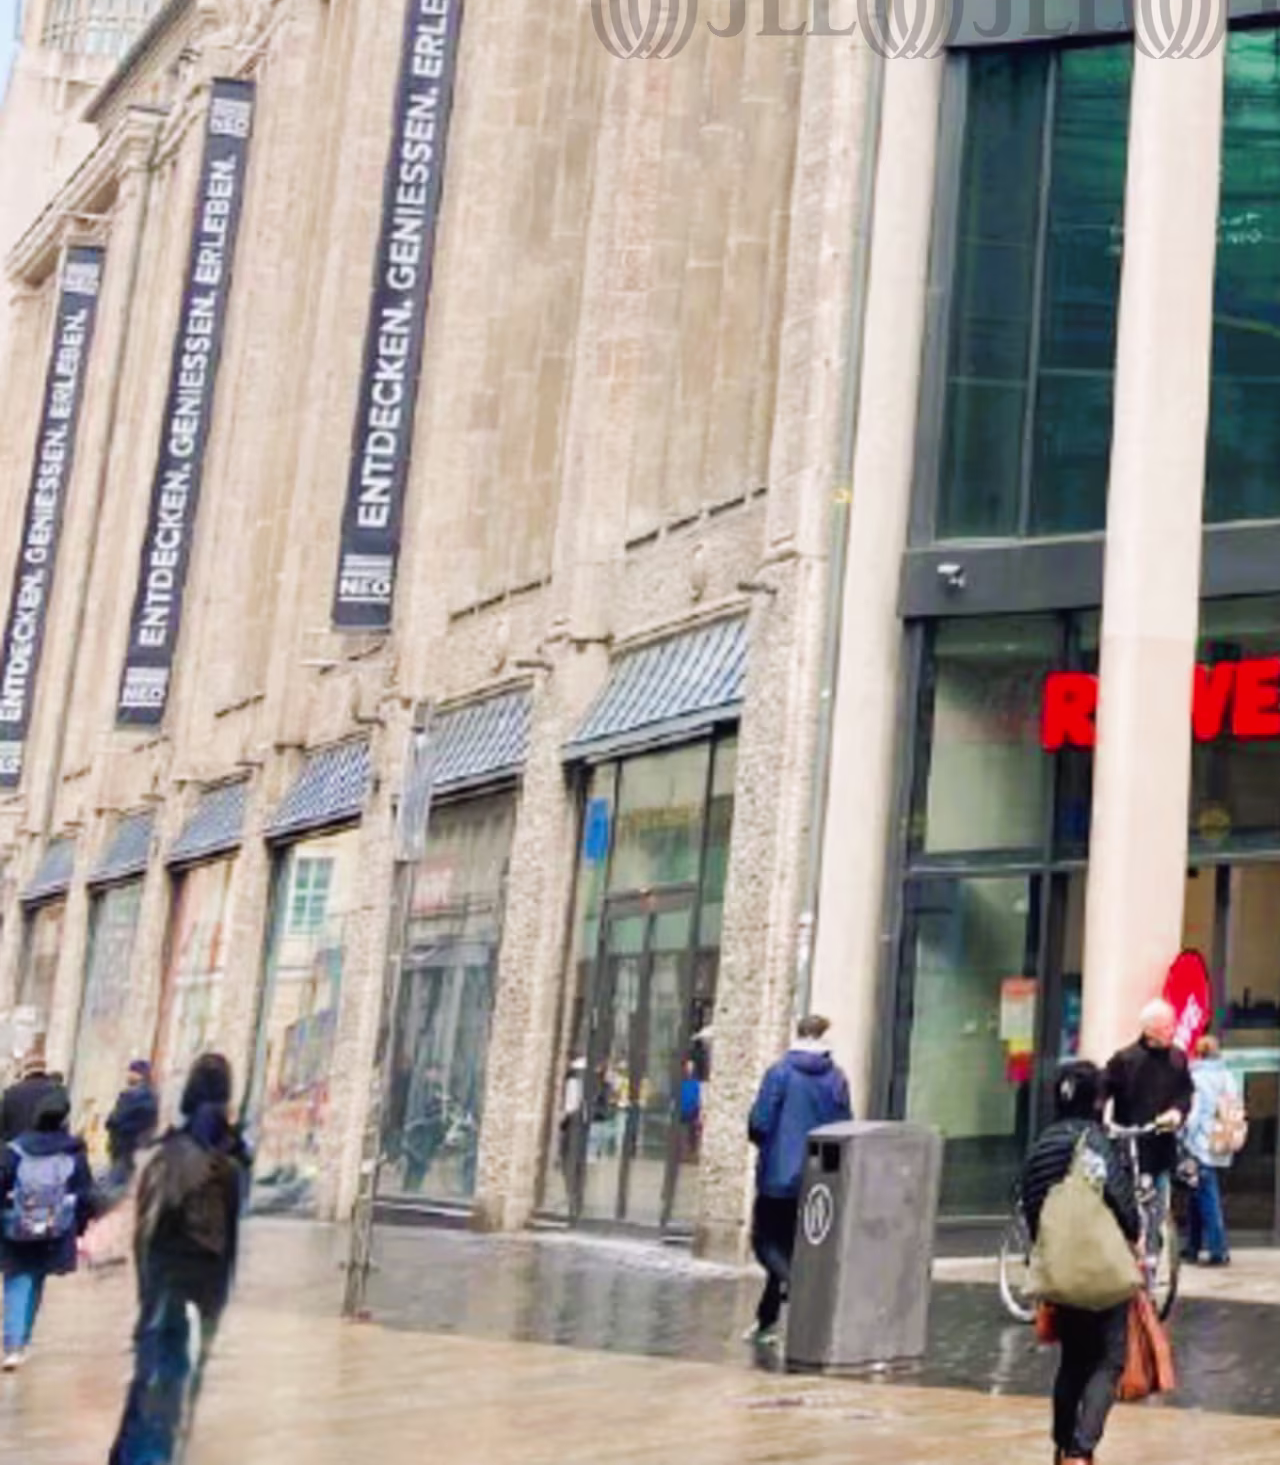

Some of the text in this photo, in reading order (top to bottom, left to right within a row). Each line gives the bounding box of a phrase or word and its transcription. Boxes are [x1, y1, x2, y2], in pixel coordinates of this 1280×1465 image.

[386, 86, 440, 290] GENIESSEN.
[0, 569, 44, 722] ENTDECKEN.
[25, 423, 68, 564] GENIESSEN.
[50, 307, 88, 420] ERLEBEN.
[139, 153, 237, 647] ENTDECKEN. GENIESSEN. ERLEBEN.
[358, 301, 415, 527] ENTDECKEN.
